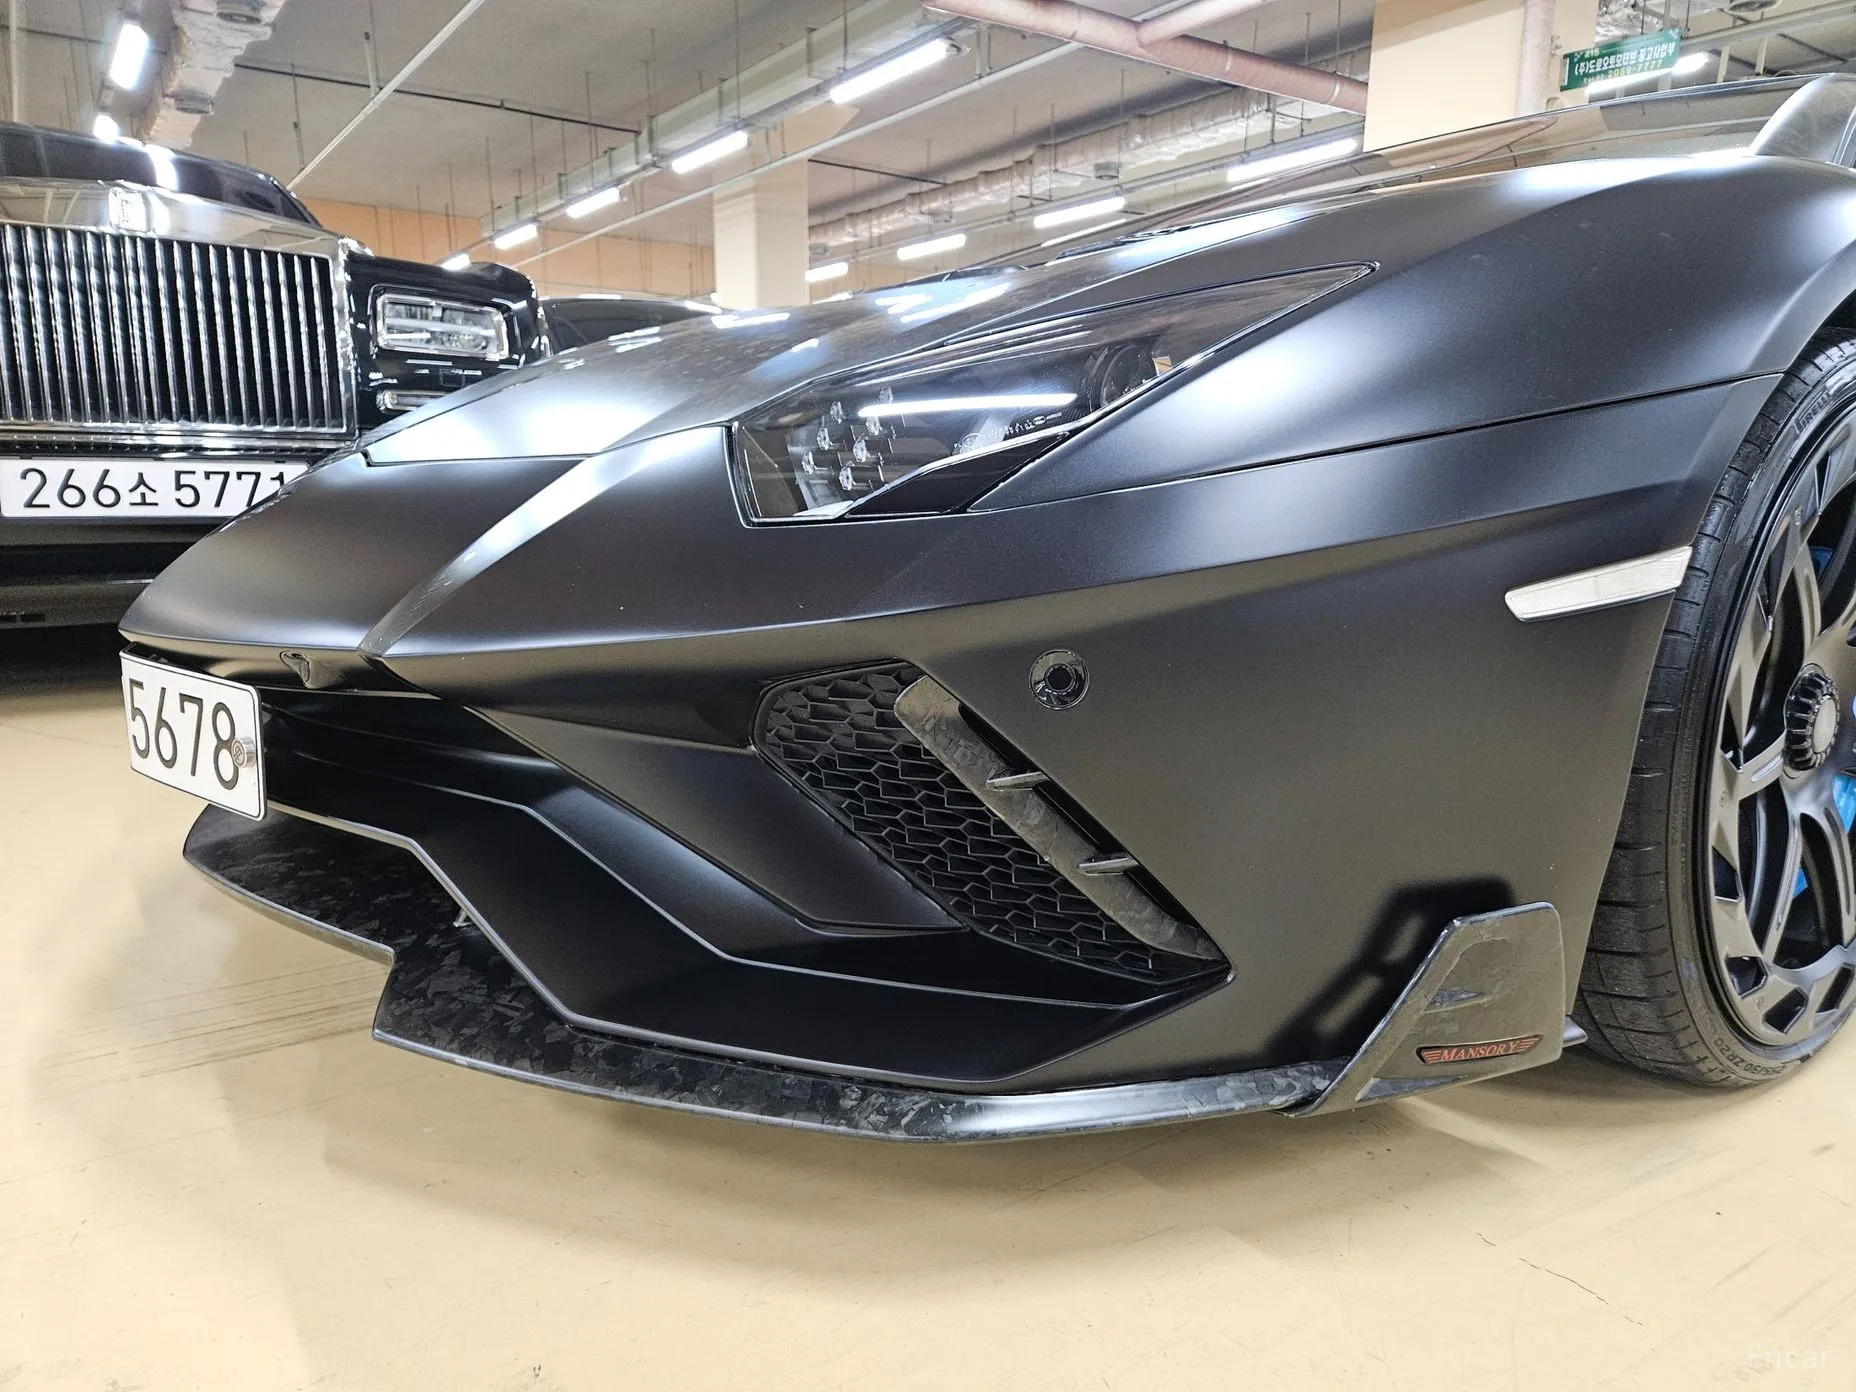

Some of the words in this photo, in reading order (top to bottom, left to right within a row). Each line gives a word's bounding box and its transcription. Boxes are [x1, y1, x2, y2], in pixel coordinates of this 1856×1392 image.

[20, 467, 159, 508] 266소
[128, 677, 239, 791] 5678
[1441, 1041, 1520, 1060] MANSORY
